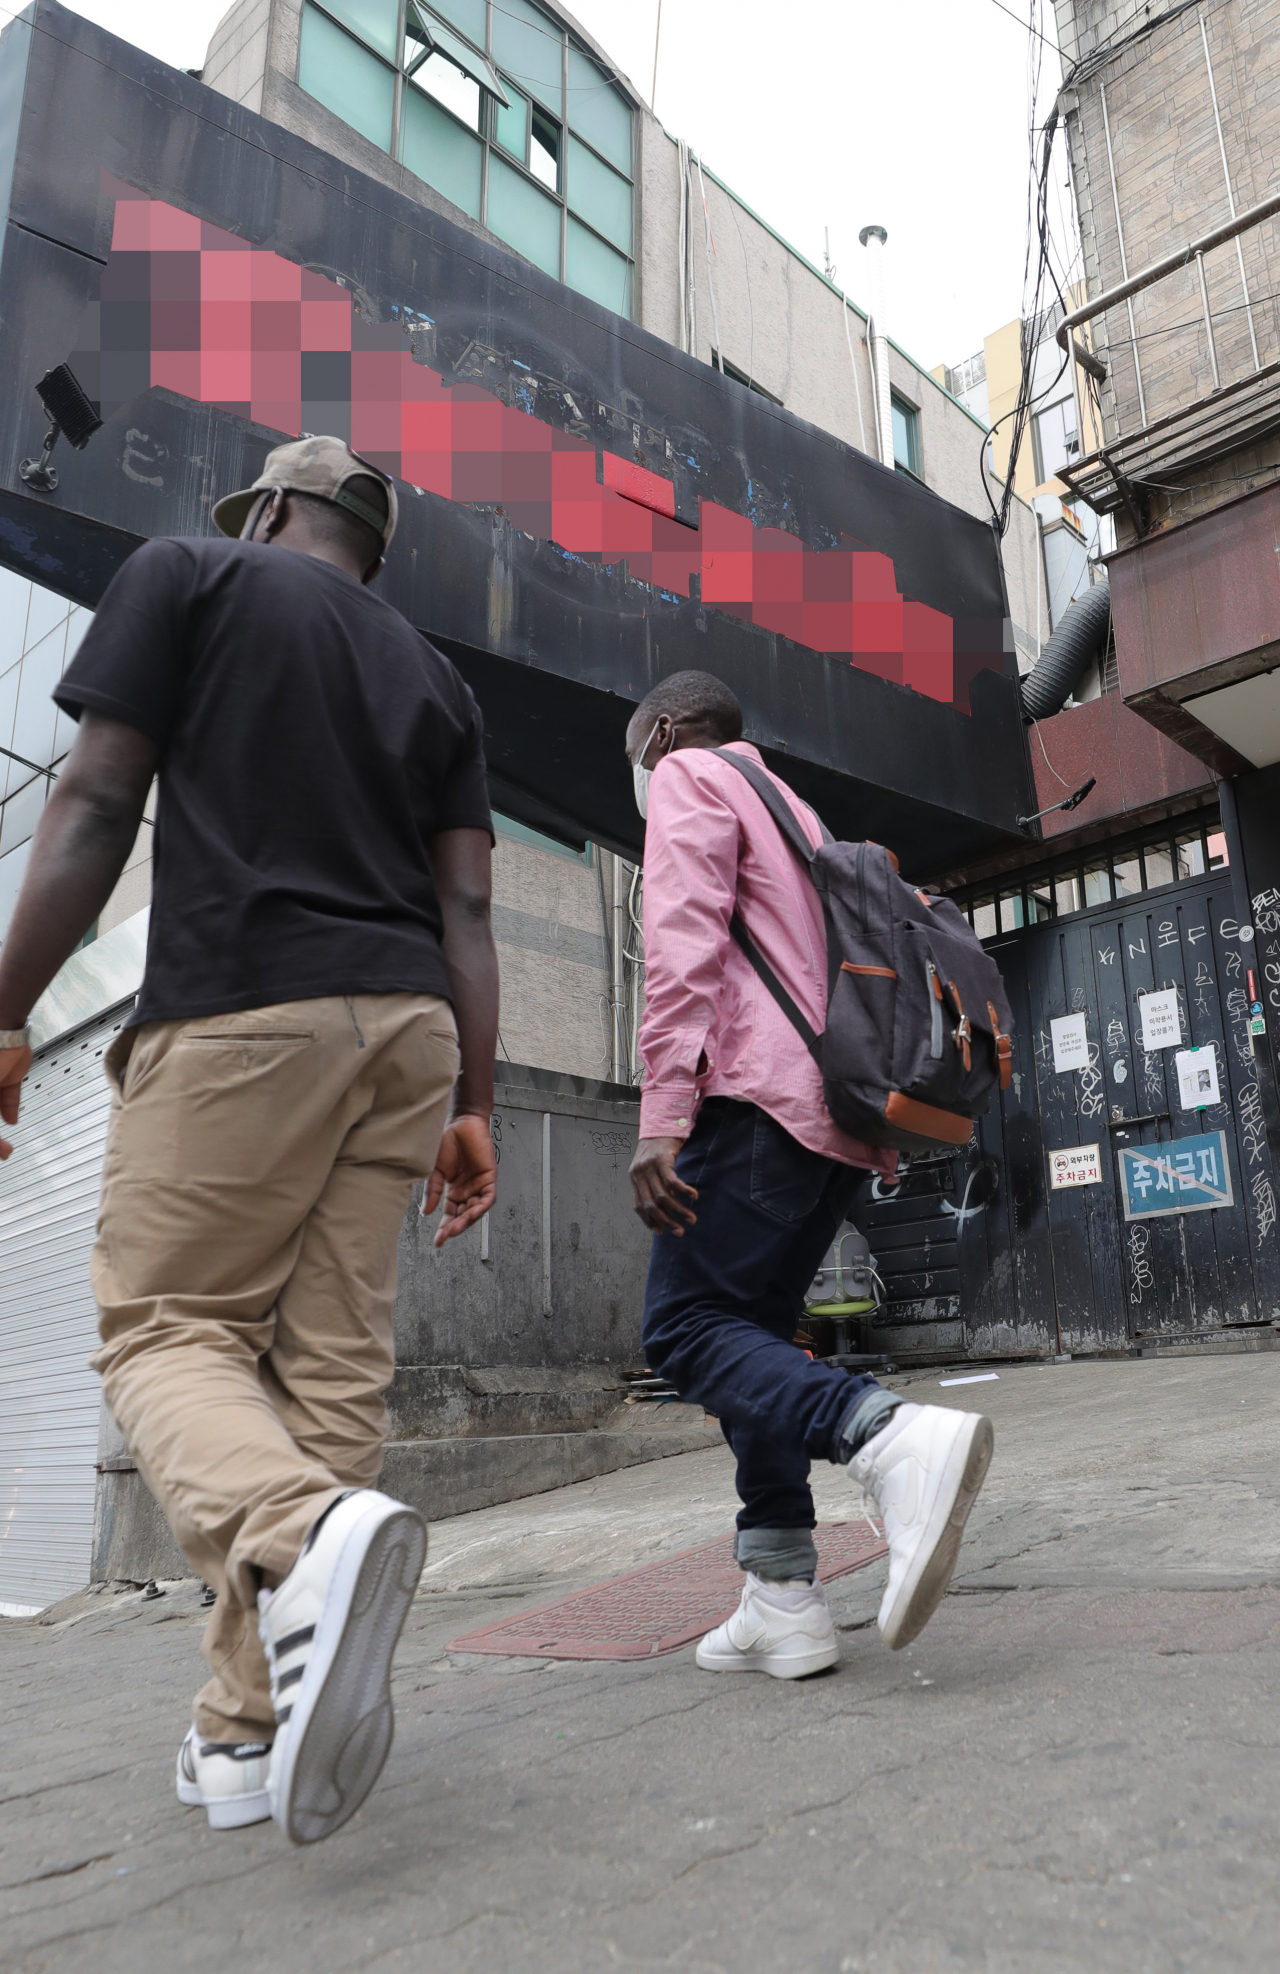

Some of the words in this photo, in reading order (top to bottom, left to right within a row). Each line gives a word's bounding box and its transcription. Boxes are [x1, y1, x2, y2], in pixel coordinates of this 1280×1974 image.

[1151, 1004, 1168, 1013] 마스크
[1149, 1014, 1173, 1025] 미착용시
[1150, 1025, 1174, 1037] 입장불가
[1070, 1153, 1095, 1165] 외부차량
[1056, 1167, 1097, 1184] 주차금지
[1132, 1146, 1219, 1198] 주차금지
